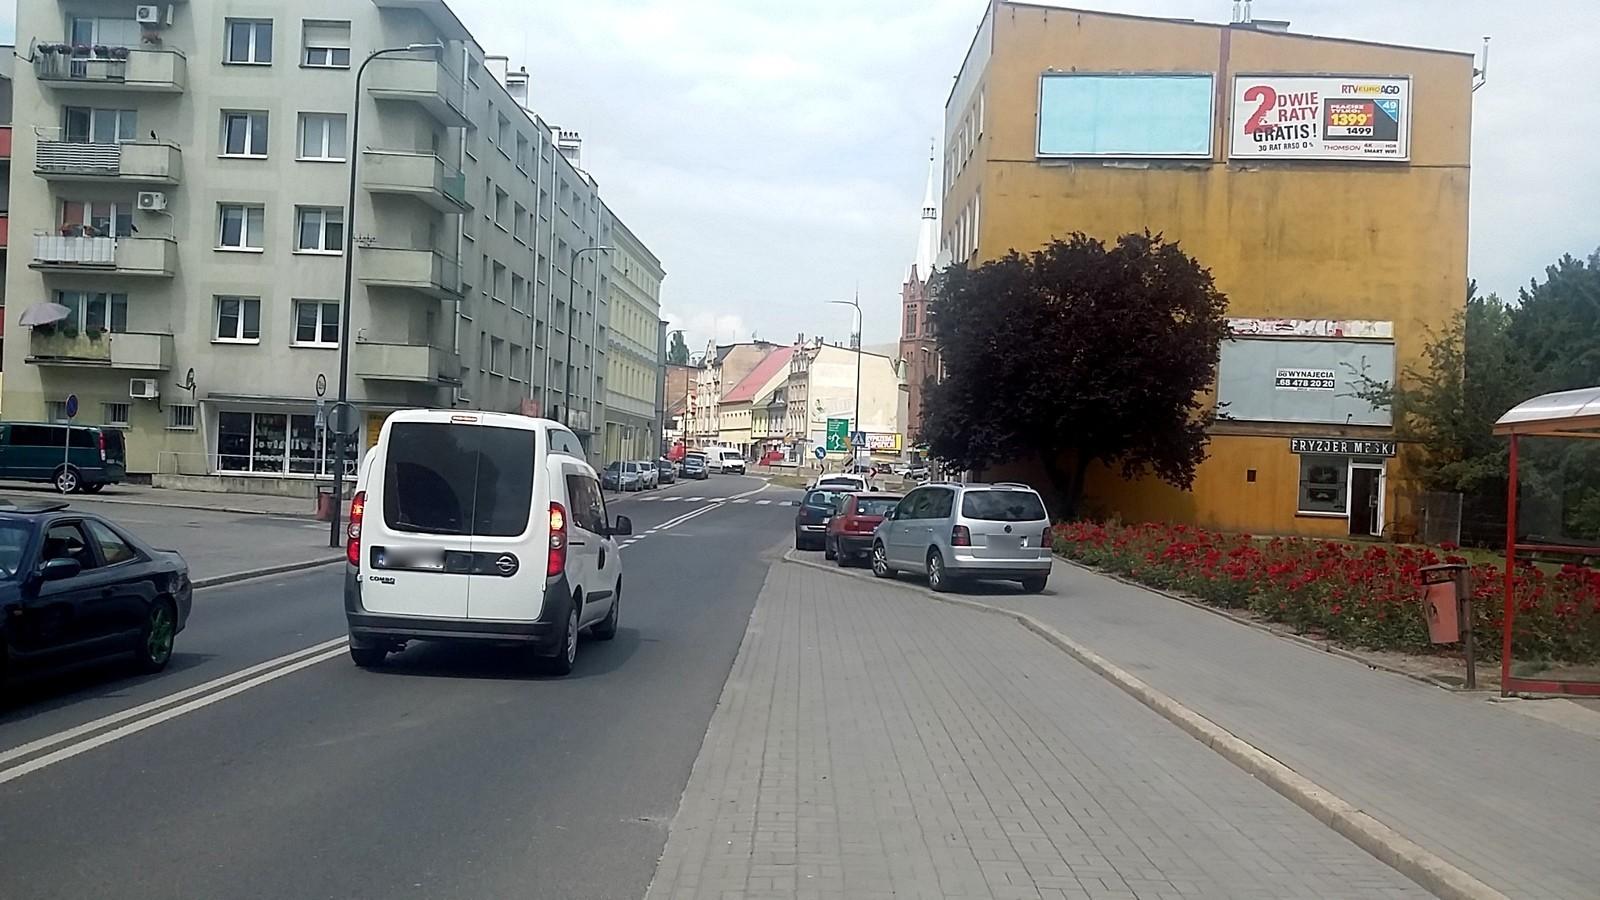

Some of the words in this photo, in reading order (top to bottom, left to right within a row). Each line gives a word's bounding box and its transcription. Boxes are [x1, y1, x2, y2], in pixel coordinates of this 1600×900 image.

[1278, 92, 1319, 107] DWIE
[1244, 85, 1277, 135] 2
[1279, 106, 1319, 122] RATY
[1346, 127, 1371, 135] 1499
[1292, 379, 1309, 387] 478
[1322, 380, 1334, 388] 20
[1292, 440, 1348, 453] FRYZJER
